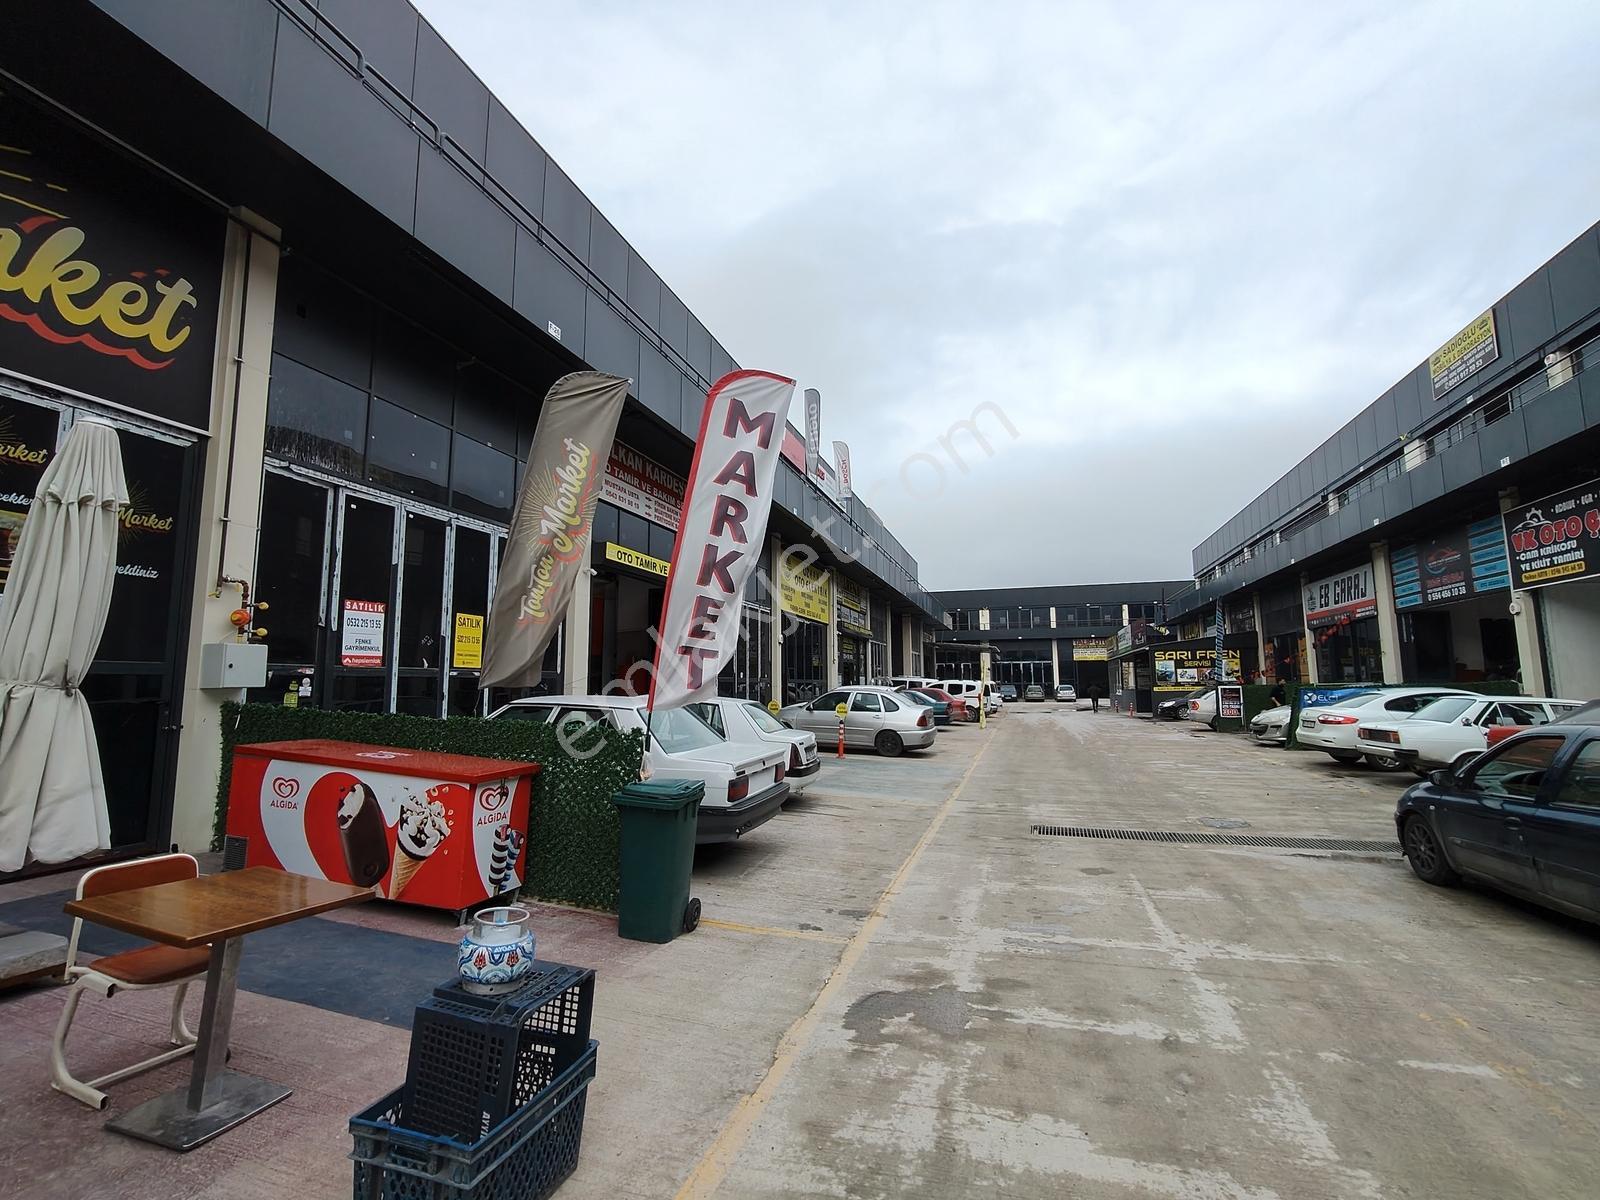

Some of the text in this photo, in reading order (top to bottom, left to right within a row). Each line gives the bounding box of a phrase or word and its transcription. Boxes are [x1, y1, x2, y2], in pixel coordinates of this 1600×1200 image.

[614, 466, 640, 489] TAMİR
[641, 482, 652, 494] VE
[540, 437, 591, 553] Market
[1539, 515, 1583, 545] OTO
[678, 398, 776, 690] MARKET
[1520, 549, 1539, 560] CAM
[1540, 540, 1577, 556] KRİKOSU
[617, 550, 668, 576] OTO TAMİR VE
[1521, 563, 1531, 571] VE
[1319, 571, 1367, 608] EB GARAJ
[345, 601, 384, 612] SATILIK
[347, 617, 382, 629] 0532 215 13 55
[458, 616, 481, 629] SATILIK
[1154, 649, 1241, 660] SARI FREN
